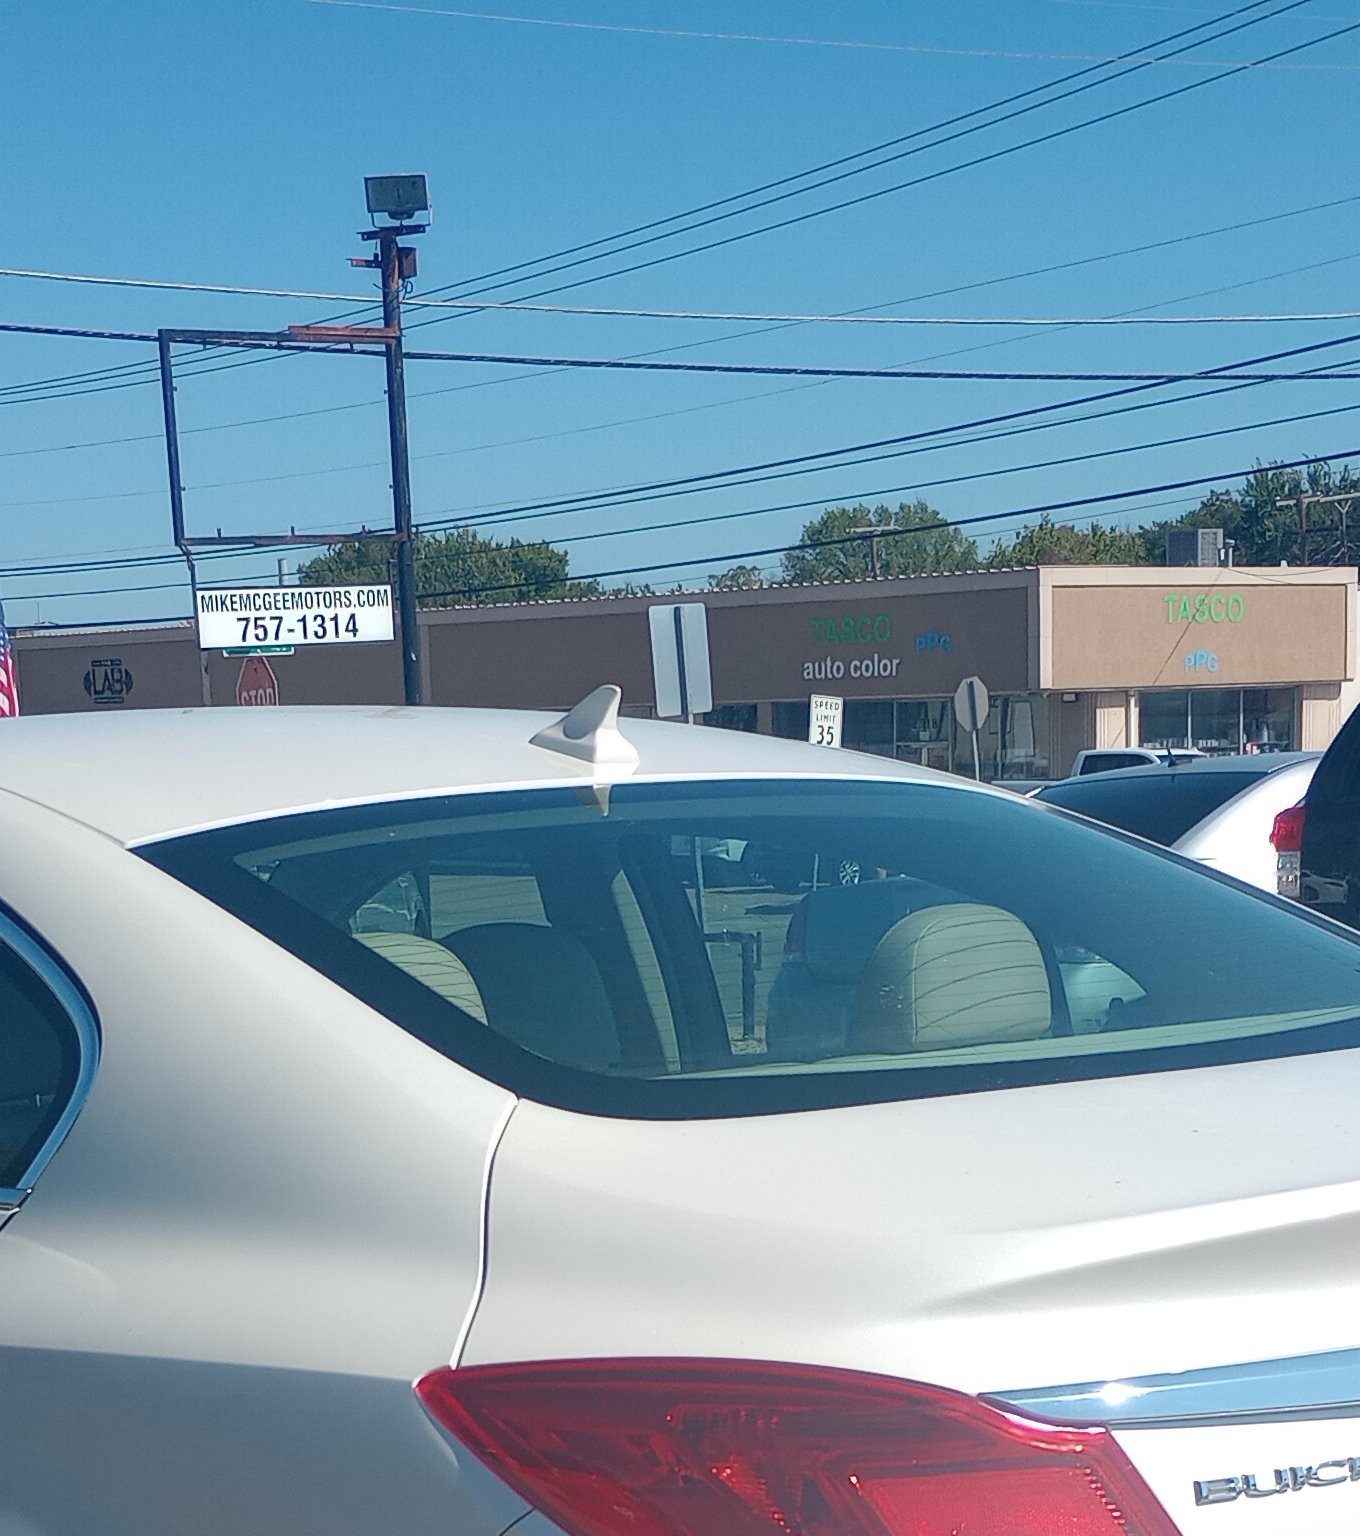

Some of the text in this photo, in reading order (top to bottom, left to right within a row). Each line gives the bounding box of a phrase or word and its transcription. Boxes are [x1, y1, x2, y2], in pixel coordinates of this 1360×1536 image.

[200, 588, 390, 613] MIKEMCGEEMOTORS.COM
[1163, 593, 1246, 624] TASCO
[236, 613, 359, 643] 757-1314
[810, 614, 892, 644] TASCO
[915, 630, 953, 655] PPG
[803, 654, 901, 681] auto color
[1184, 649, 1219, 673] PPG
[92, 668, 124, 696] LAB
[814, 701, 840, 711] SPEED
[816, 714, 836, 725] LIMIT
[816, 725, 834, 745] 35
